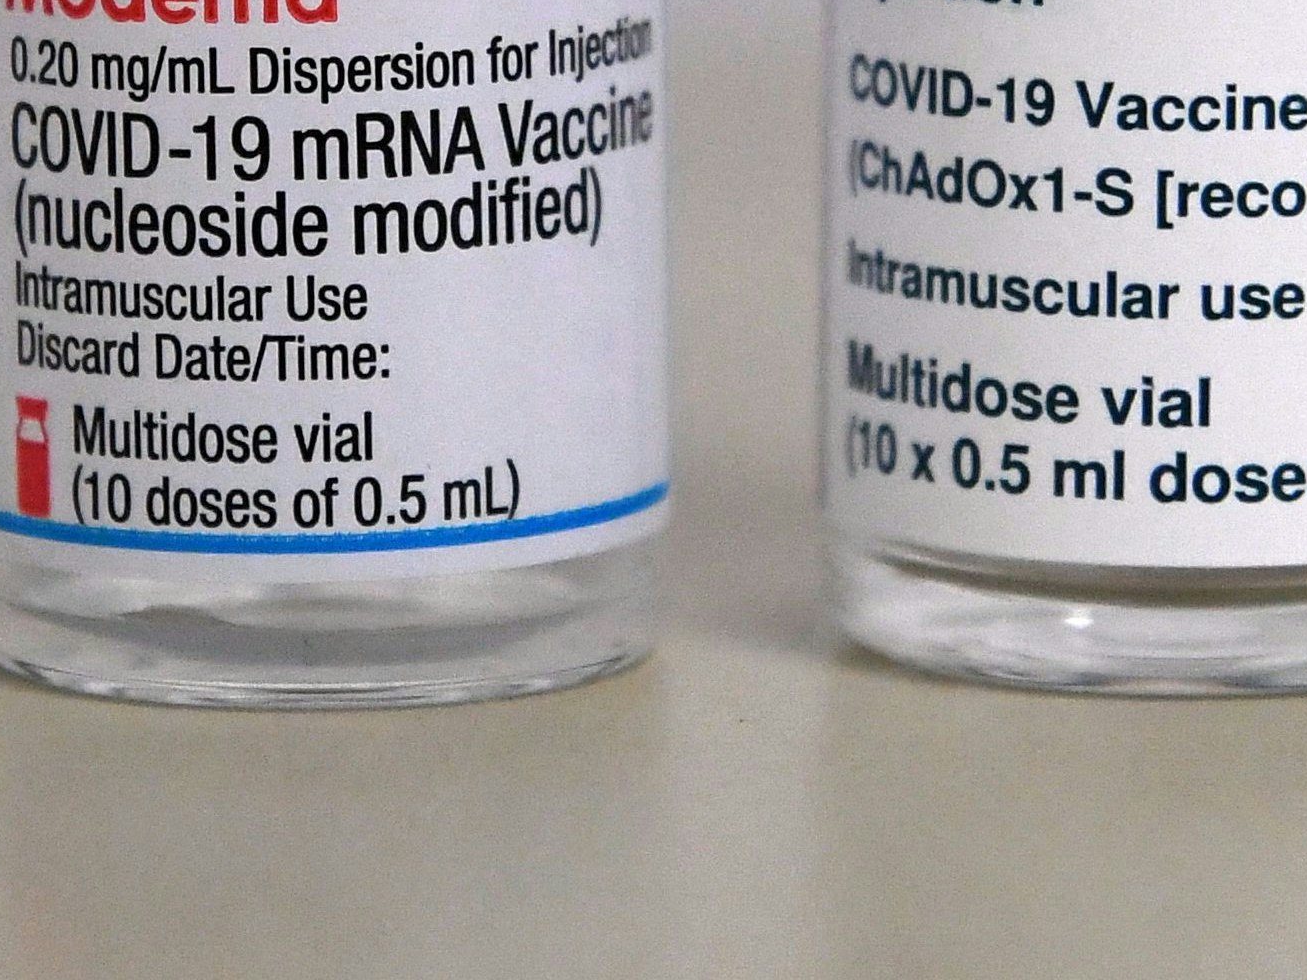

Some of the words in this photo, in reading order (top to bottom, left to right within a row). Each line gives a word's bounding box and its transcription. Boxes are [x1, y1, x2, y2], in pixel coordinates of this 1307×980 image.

[11, 35, 78, 87] 0.20
[92, 45, 235, 103] mg/mL
[250, 42, 474, 104] Dispersion
[488, 35, 539, 83] for
[549, 16, 651, 82] Injection
[850, 55, 1055, 126] COVID-19
[11, 102, 271, 182] COVID-19
[293, 106, 484, 180] mRNA
[498, 85, 653, 167] Vaccine
[14, 178, 328, 257] (nucleoside
[353, 168, 603, 252] modified)
[850, 140, 1134, 217] (ChAdOx1-S
[15, 261, 273, 321] Intramuscular
[286, 275, 367, 321] Use
[847, 240, 1180, 319] Intramuscular
[1201, 281, 1306, 320] use
[17, 320, 140, 378] Discard
[155, 335, 391, 382] Date/Time:
[847, 339, 1079, 422] Multidose
[1102, 376, 1211, 427] vial
[73, 404, 278, 464] Multidose
[294, 413, 373, 462] vial
[847, 415, 896, 473] (10
[912, 443, 935, 482] x
[952, 438, 1030, 496] 0.5
[1054, 450, 1125, 500] ml
[72, 465, 132, 527] (10
[146, 475, 276, 527] doses
[294, 477, 339, 527] of
[354, 475, 428, 523] 0.5
[443, 458, 522, 520] mL)
